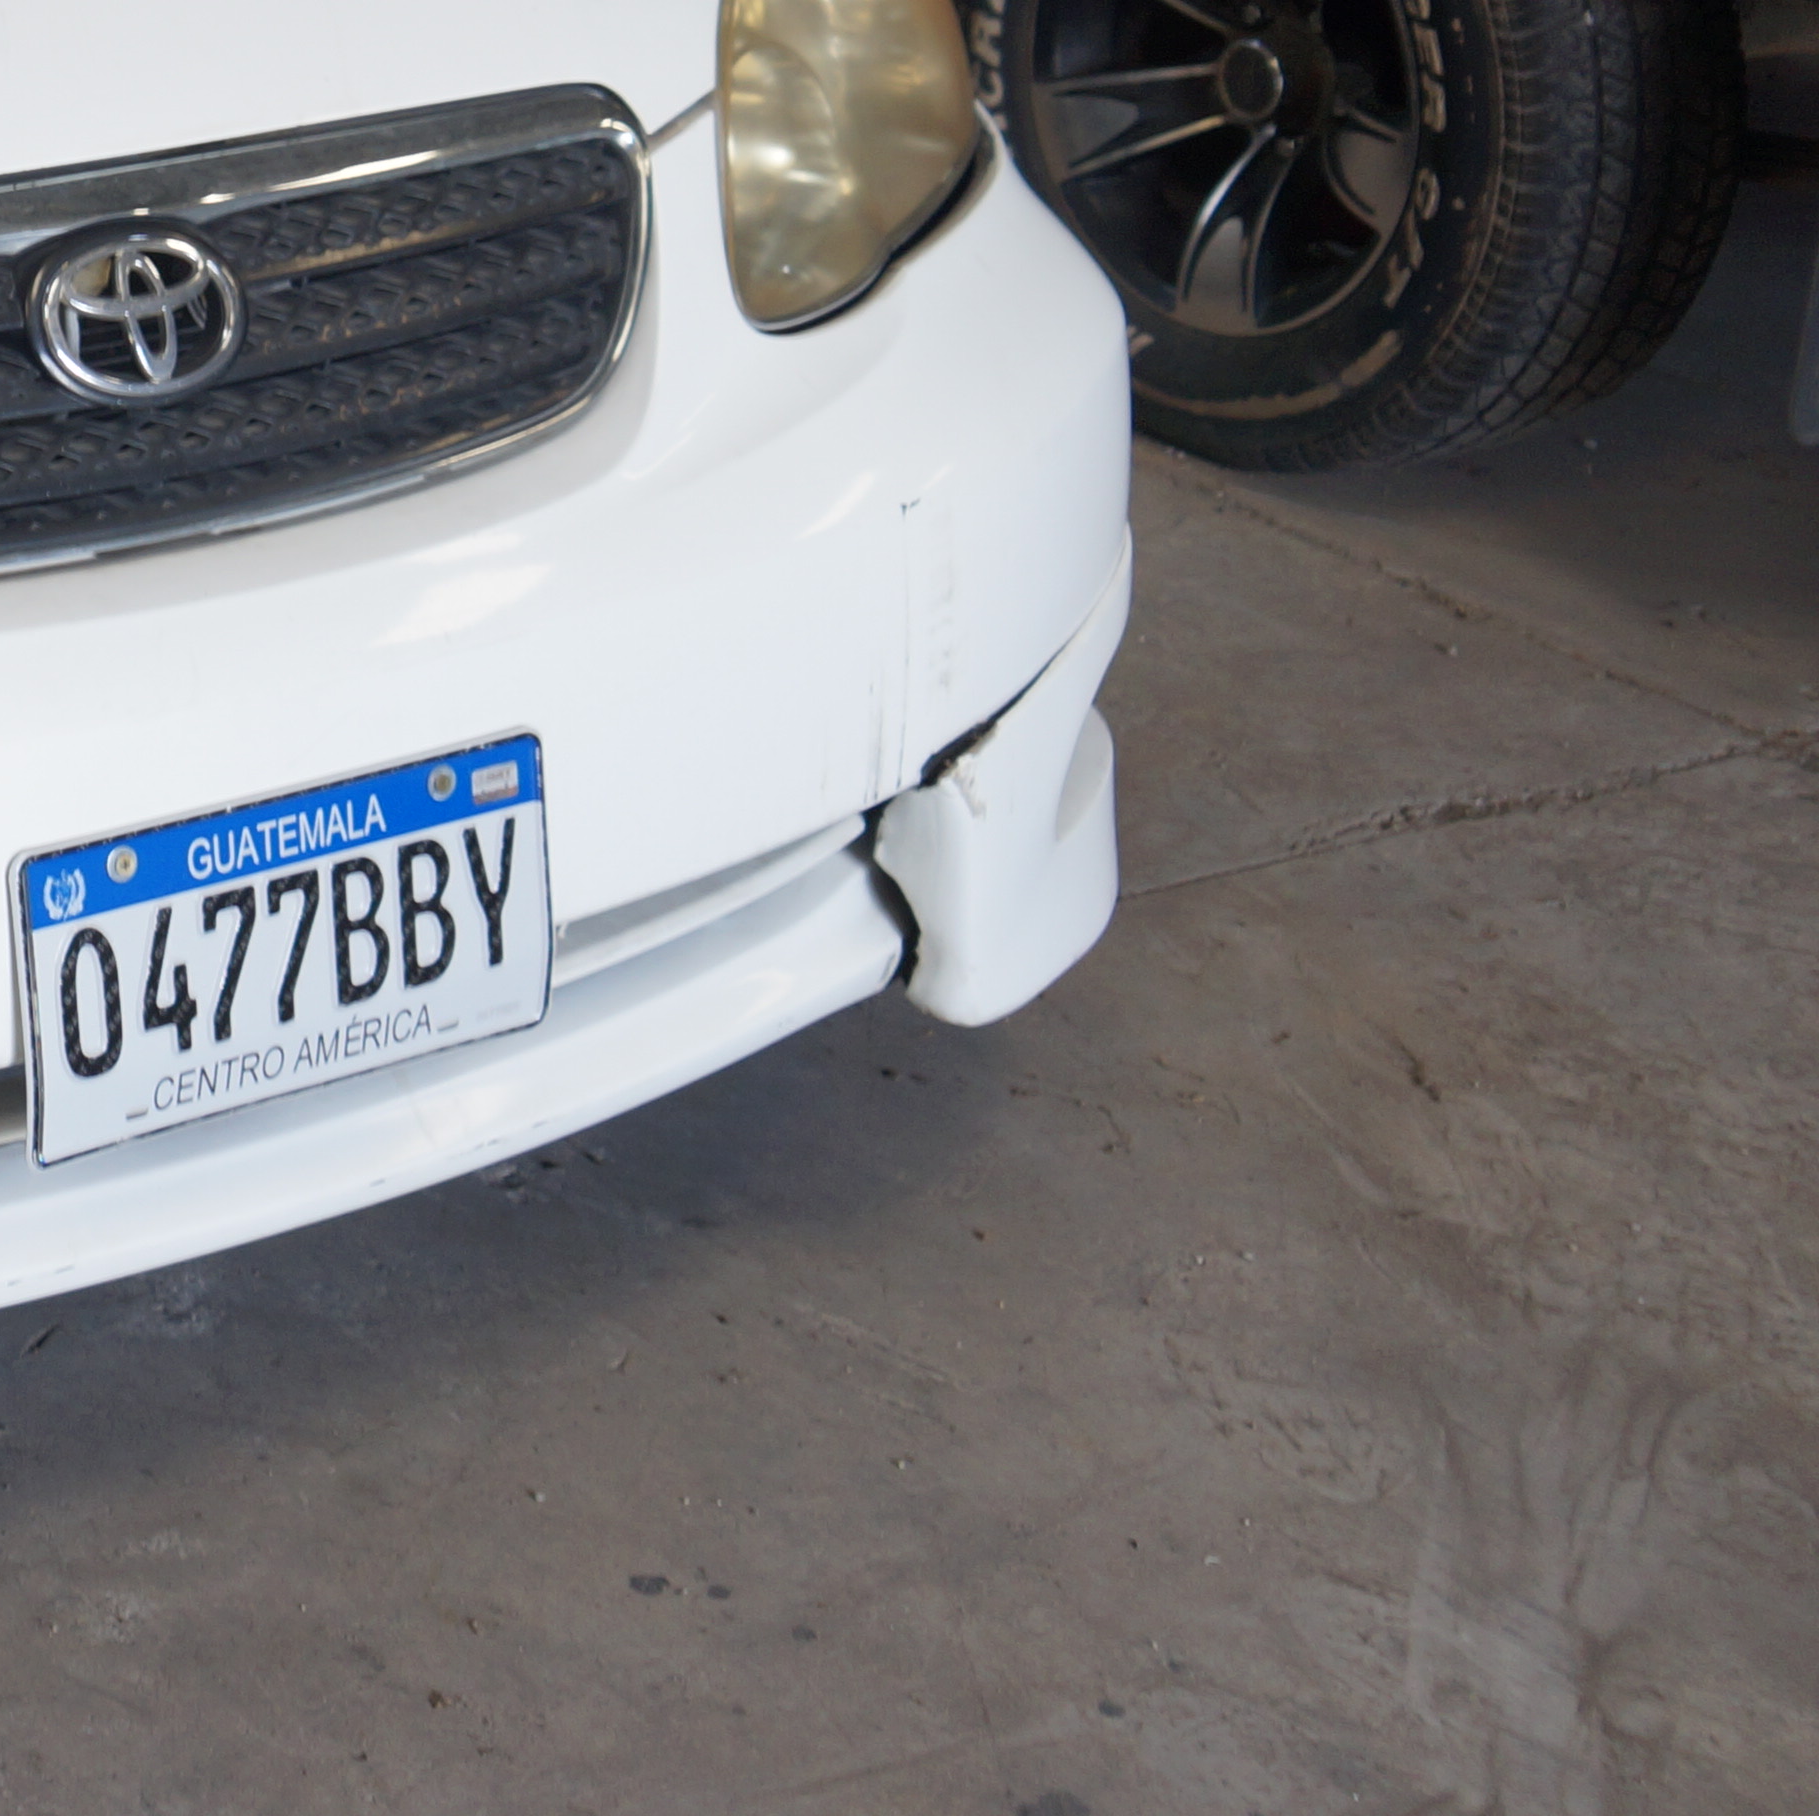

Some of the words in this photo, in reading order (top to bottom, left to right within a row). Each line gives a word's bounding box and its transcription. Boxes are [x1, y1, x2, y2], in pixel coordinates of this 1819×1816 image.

[187, 793, 387, 881] GUATEMALA
[61, 816, 517, 1078] 0477BBY
[153, 1044, 285, 1112] CENTRO
